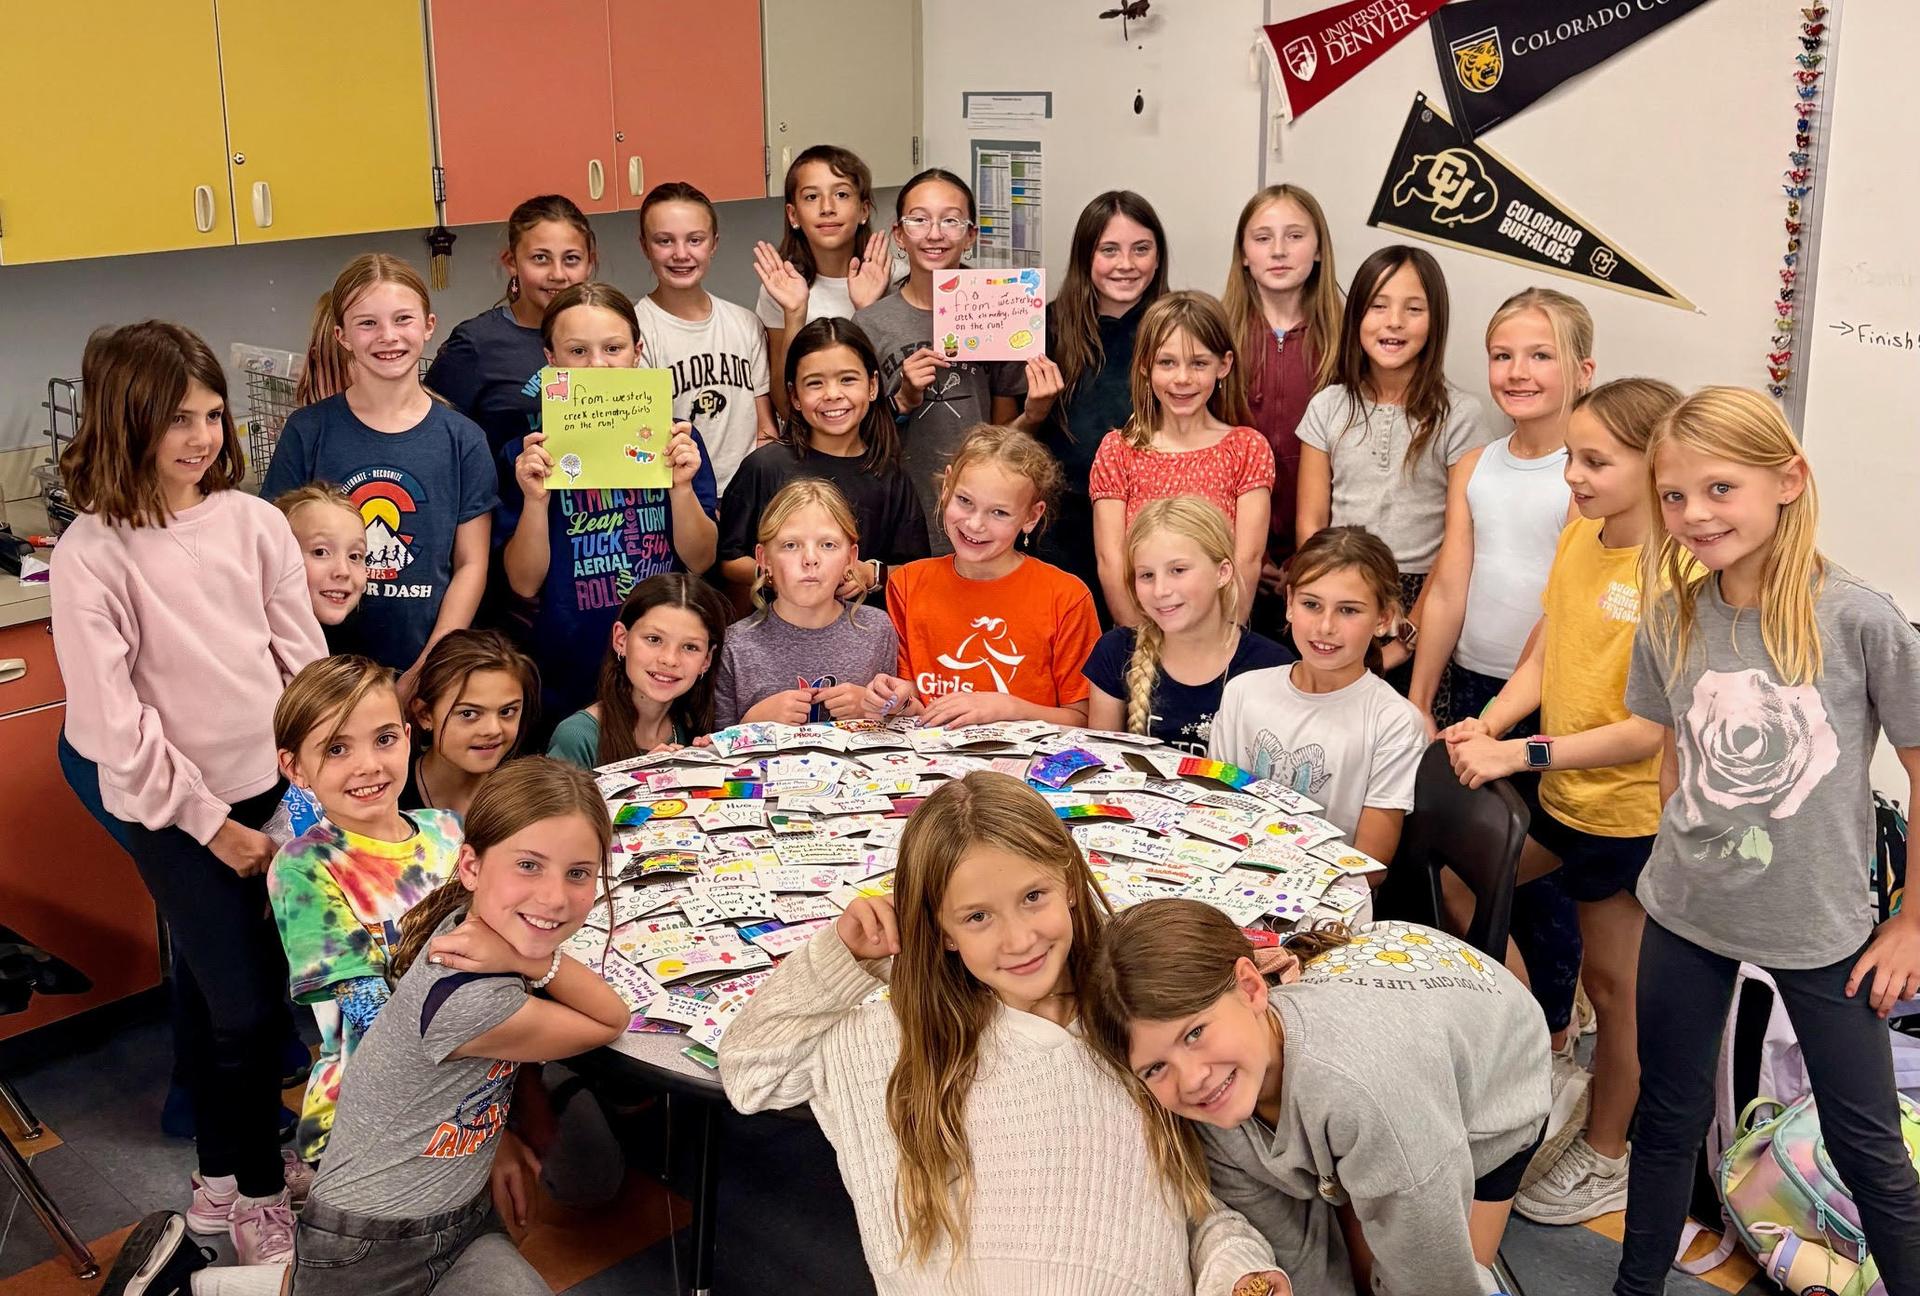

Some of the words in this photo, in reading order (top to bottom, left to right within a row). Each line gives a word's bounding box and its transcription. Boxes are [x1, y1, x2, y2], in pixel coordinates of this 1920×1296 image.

[1320, 0, 1399, 44] UNIVERSITY
[1324, 3, 1421, 65] DENVER
[1511, 2, 1632, 56] COLORADO
[1505, 199, 1583, 247] COLORADO
[1497, 216, 1575, 264] BUFFALOES
[954, 290, 990, 313] from
[970, 322, 983, 330] the
[986, 320, 1004, 329] run!
[573, 384, 604, 407] from
[612, 391, 653, 405] westerly
[580, 420, 592, 429] the
[597, 418, 615, 429] run!
[341, 472, 368, 496] CELEBRATE
[372, 469, 403, 482] RECOGNIZE
[566, 510, 626, 536] Leap
[636, 506, 666, 534] TURN
[571, 529, 624, 560] TUCK
[366, 568, 386, 580] 2025
[573, 553, 633, 578] AERIAL
[383, 584, 433, 598] DASH
[916, 672, 974, 695] Girls
[1337, 977, 1368, 986] TO
[1372, 977, 1417, 991] LIFE
[1419, 975, 1455, 990] GIVE
